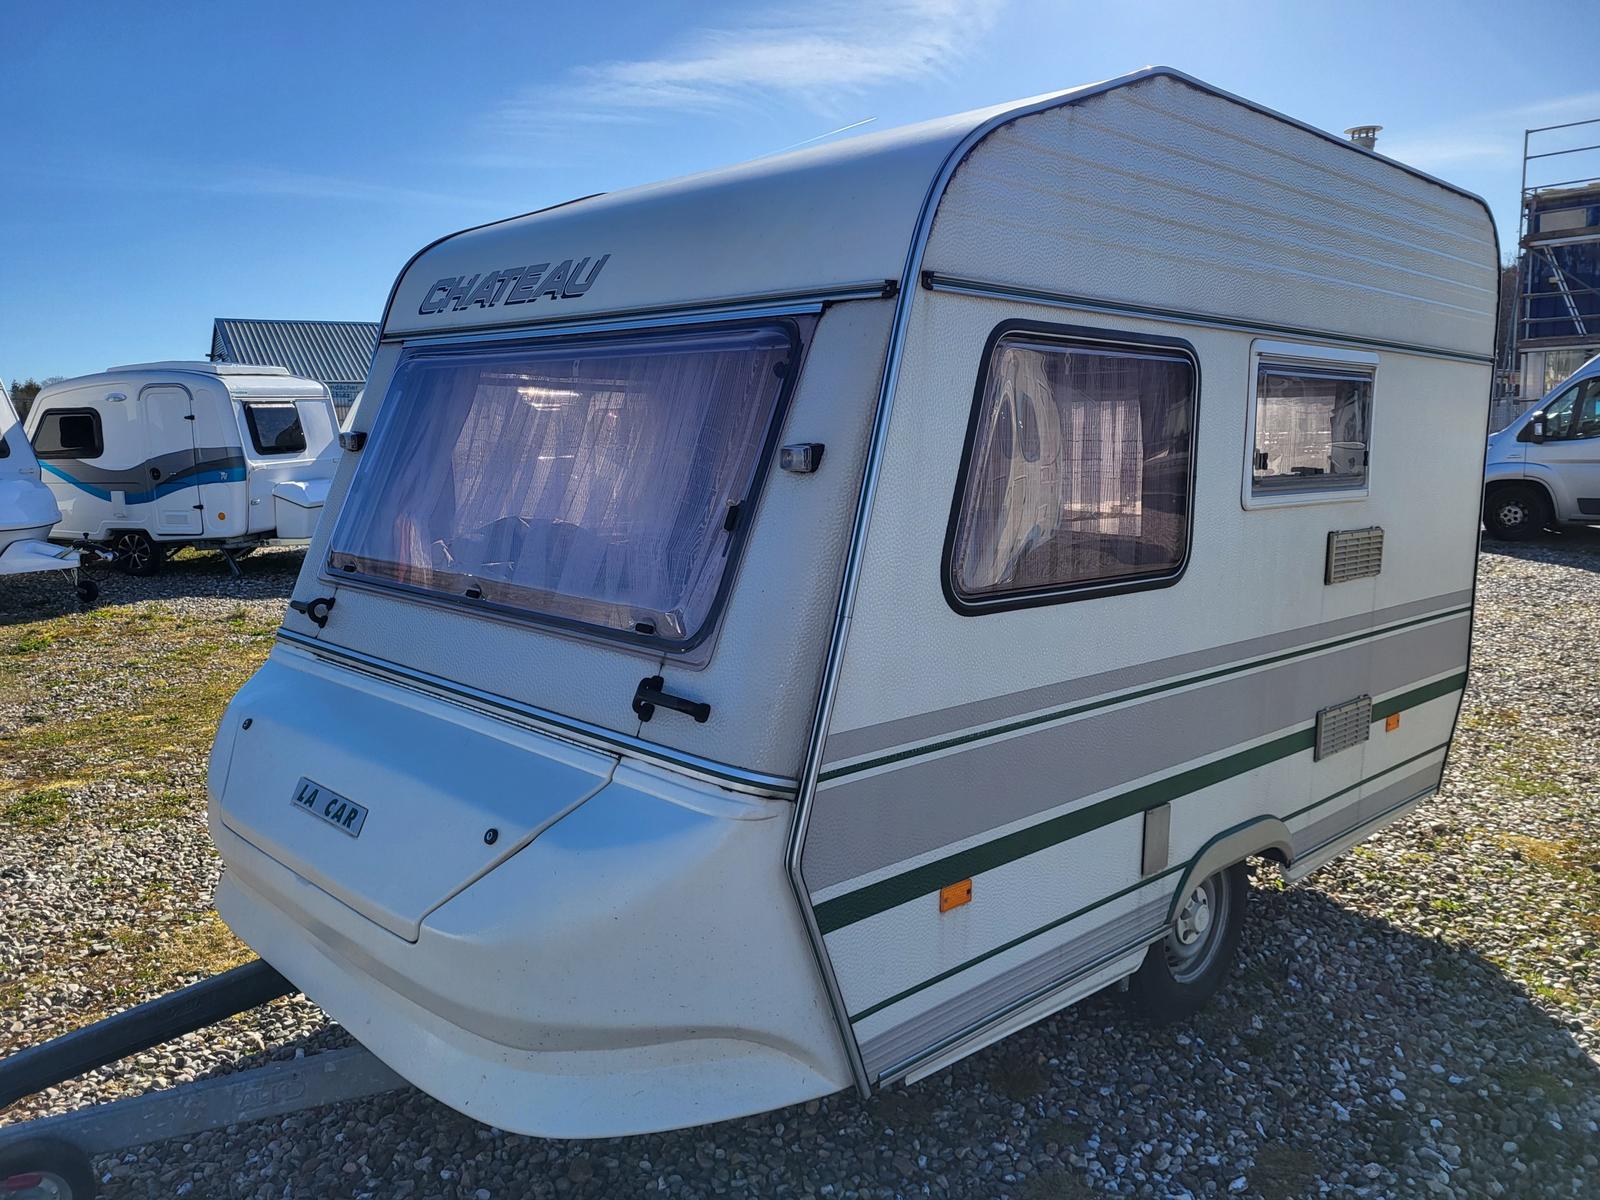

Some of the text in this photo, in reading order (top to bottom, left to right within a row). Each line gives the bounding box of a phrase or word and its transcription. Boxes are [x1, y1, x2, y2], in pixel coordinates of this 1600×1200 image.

[418, 254, 611, 315] CHATEAU
[297, 784, 359, 829] LA CAR
